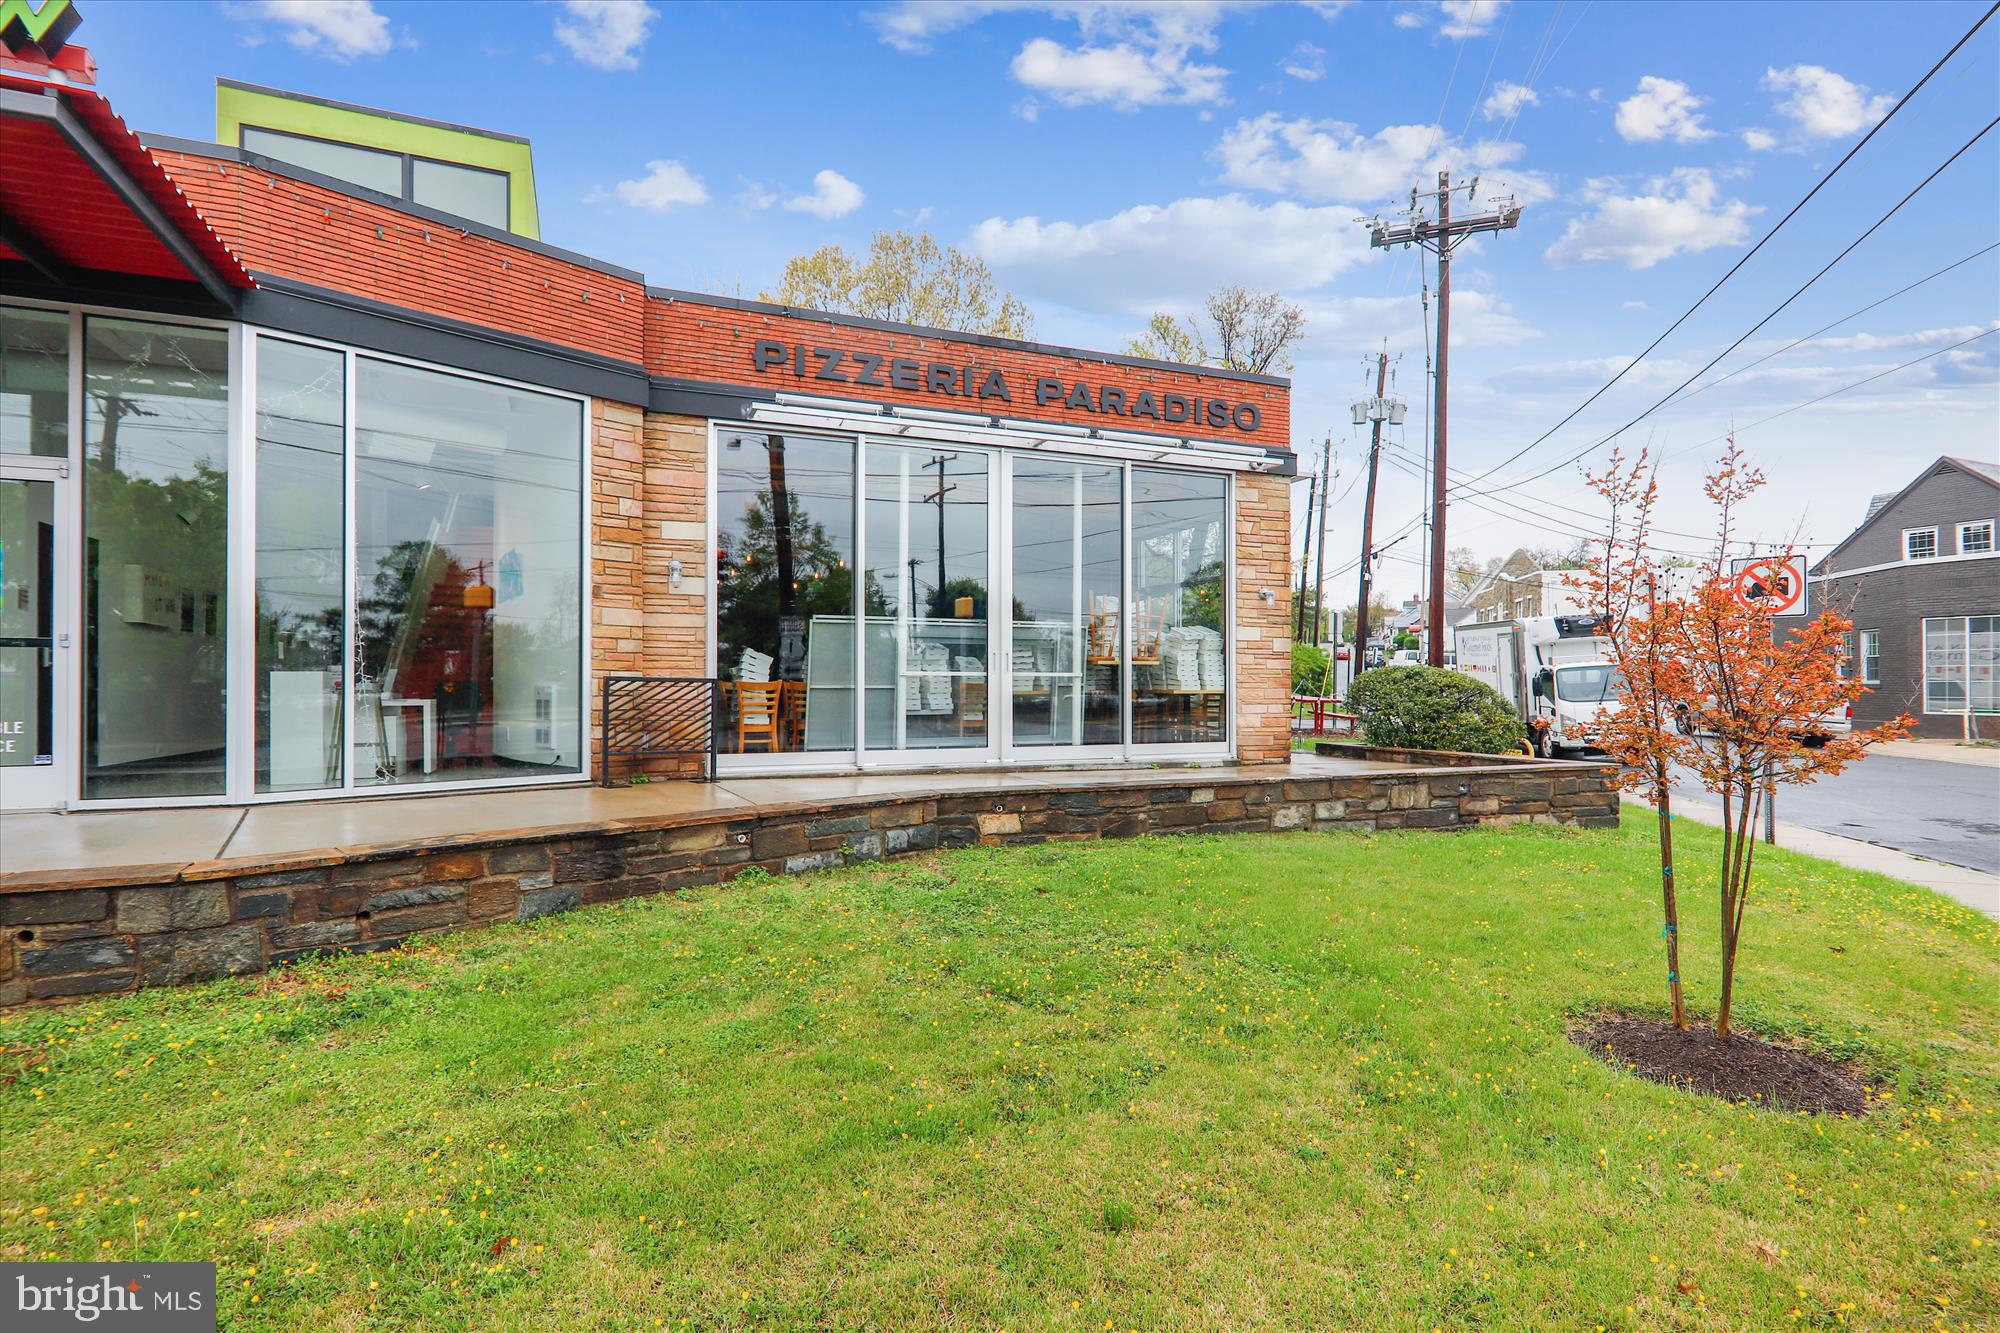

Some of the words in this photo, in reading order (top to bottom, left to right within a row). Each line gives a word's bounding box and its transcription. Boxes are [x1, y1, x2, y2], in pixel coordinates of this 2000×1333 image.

[753, 339, 1011, 402] PIZZERIA
[1035, 377, 1260, 431] PARADISO
[0, 721, 24, 734] LE
